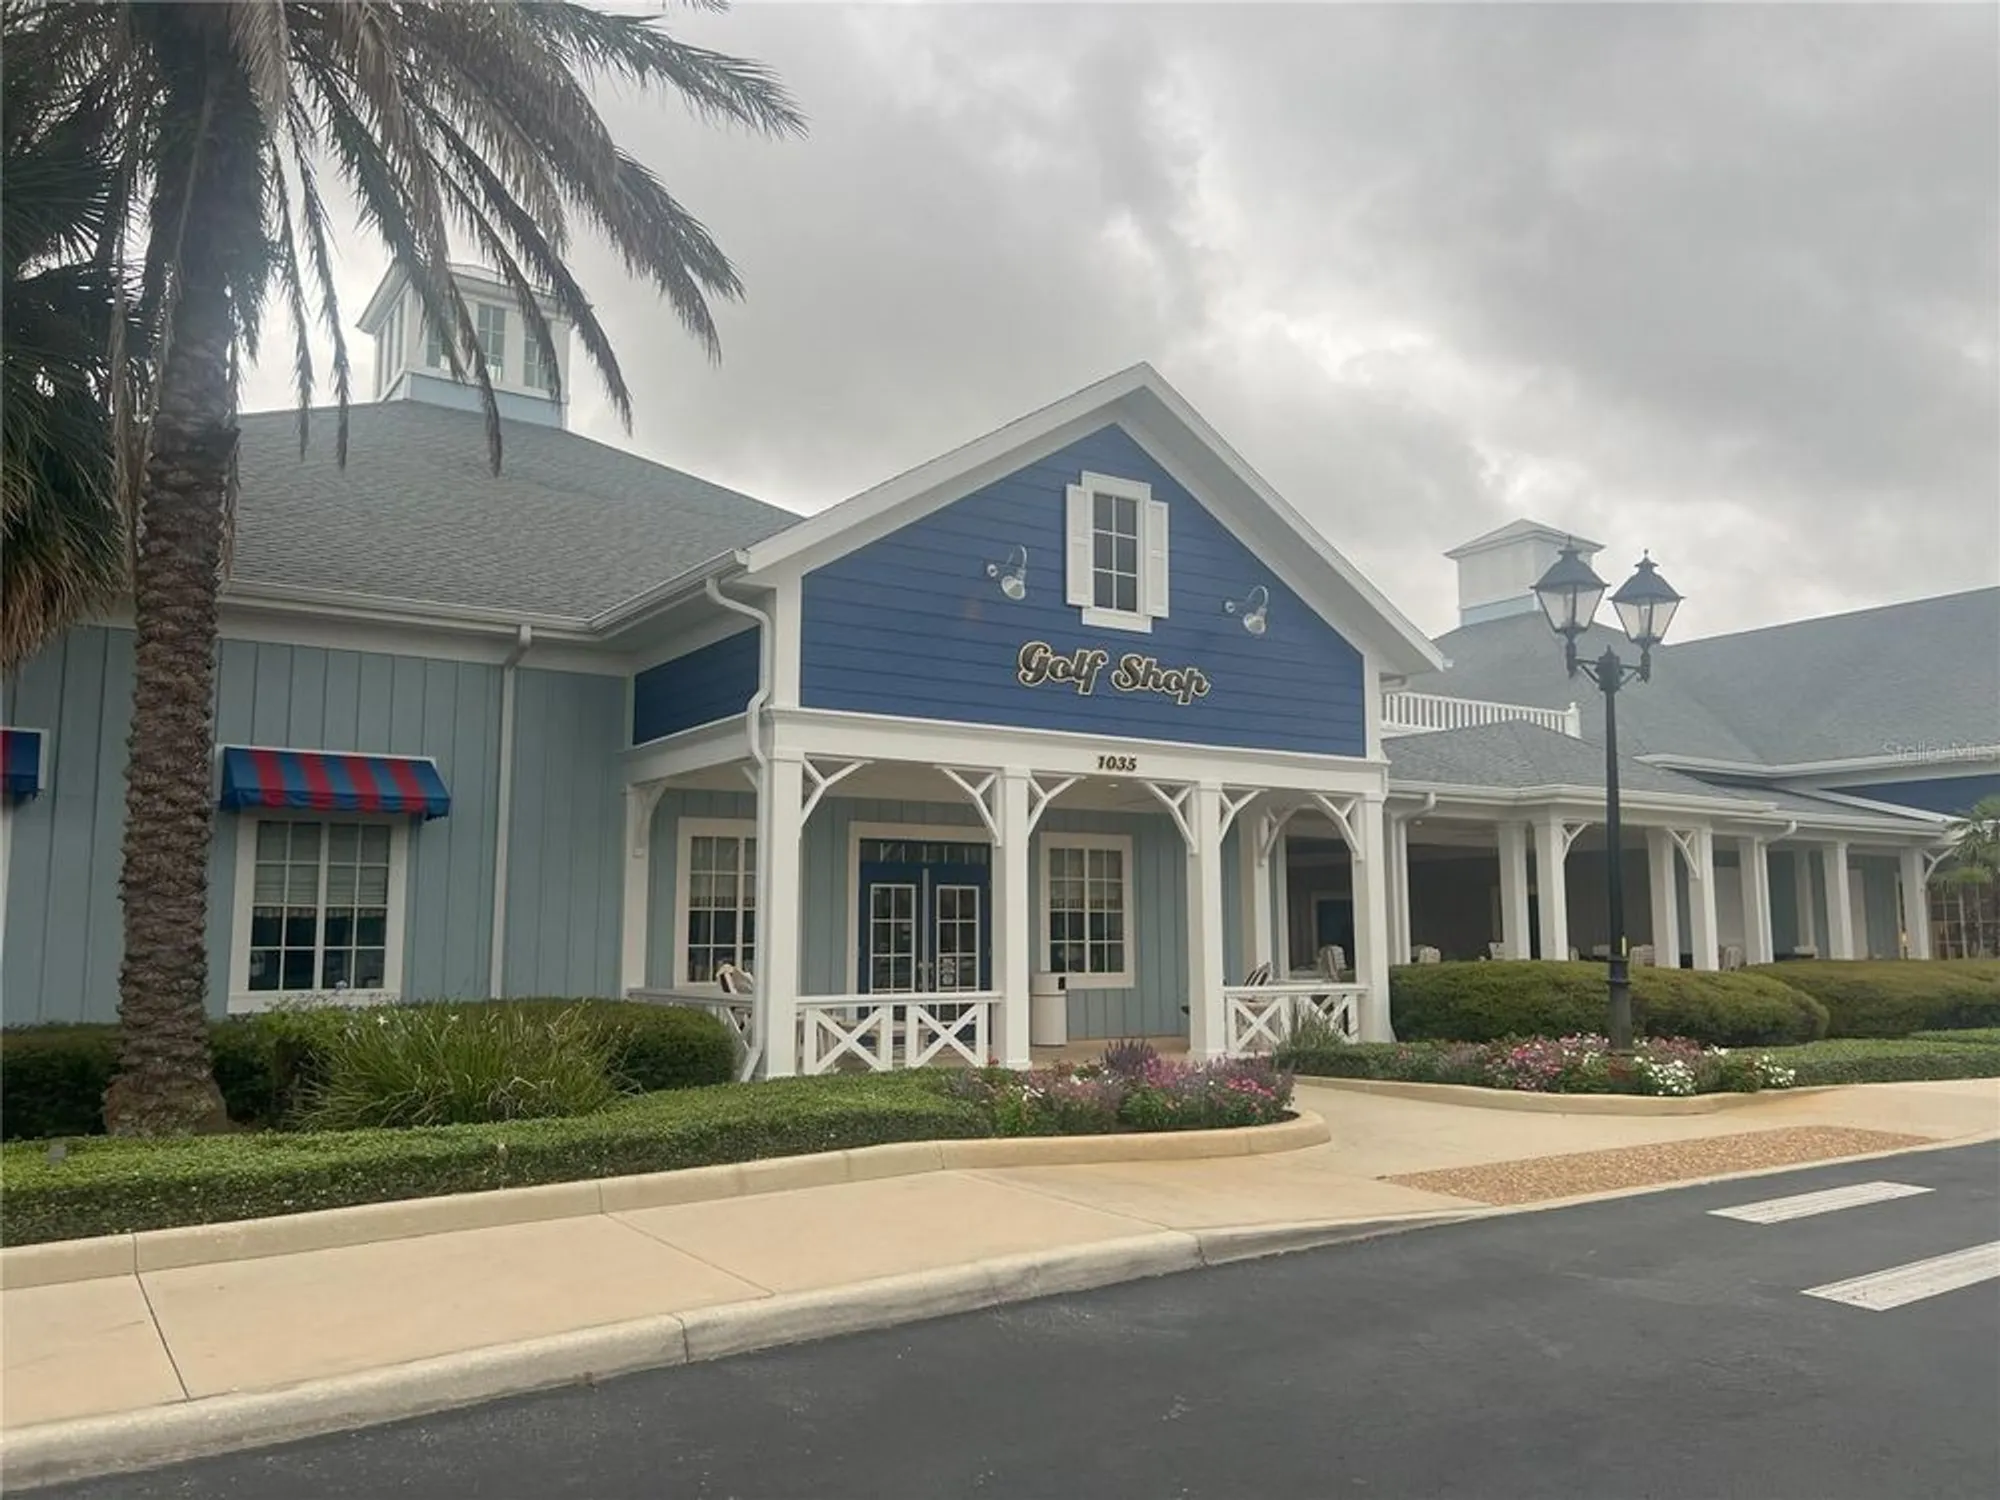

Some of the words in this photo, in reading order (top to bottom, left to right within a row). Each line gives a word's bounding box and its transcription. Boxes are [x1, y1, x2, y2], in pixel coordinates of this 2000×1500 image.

[1018, 641, 1108, 695] Golf
[1111, 654, 1211, 705] Shop
[1097, 755, 1137, 771] 1035
